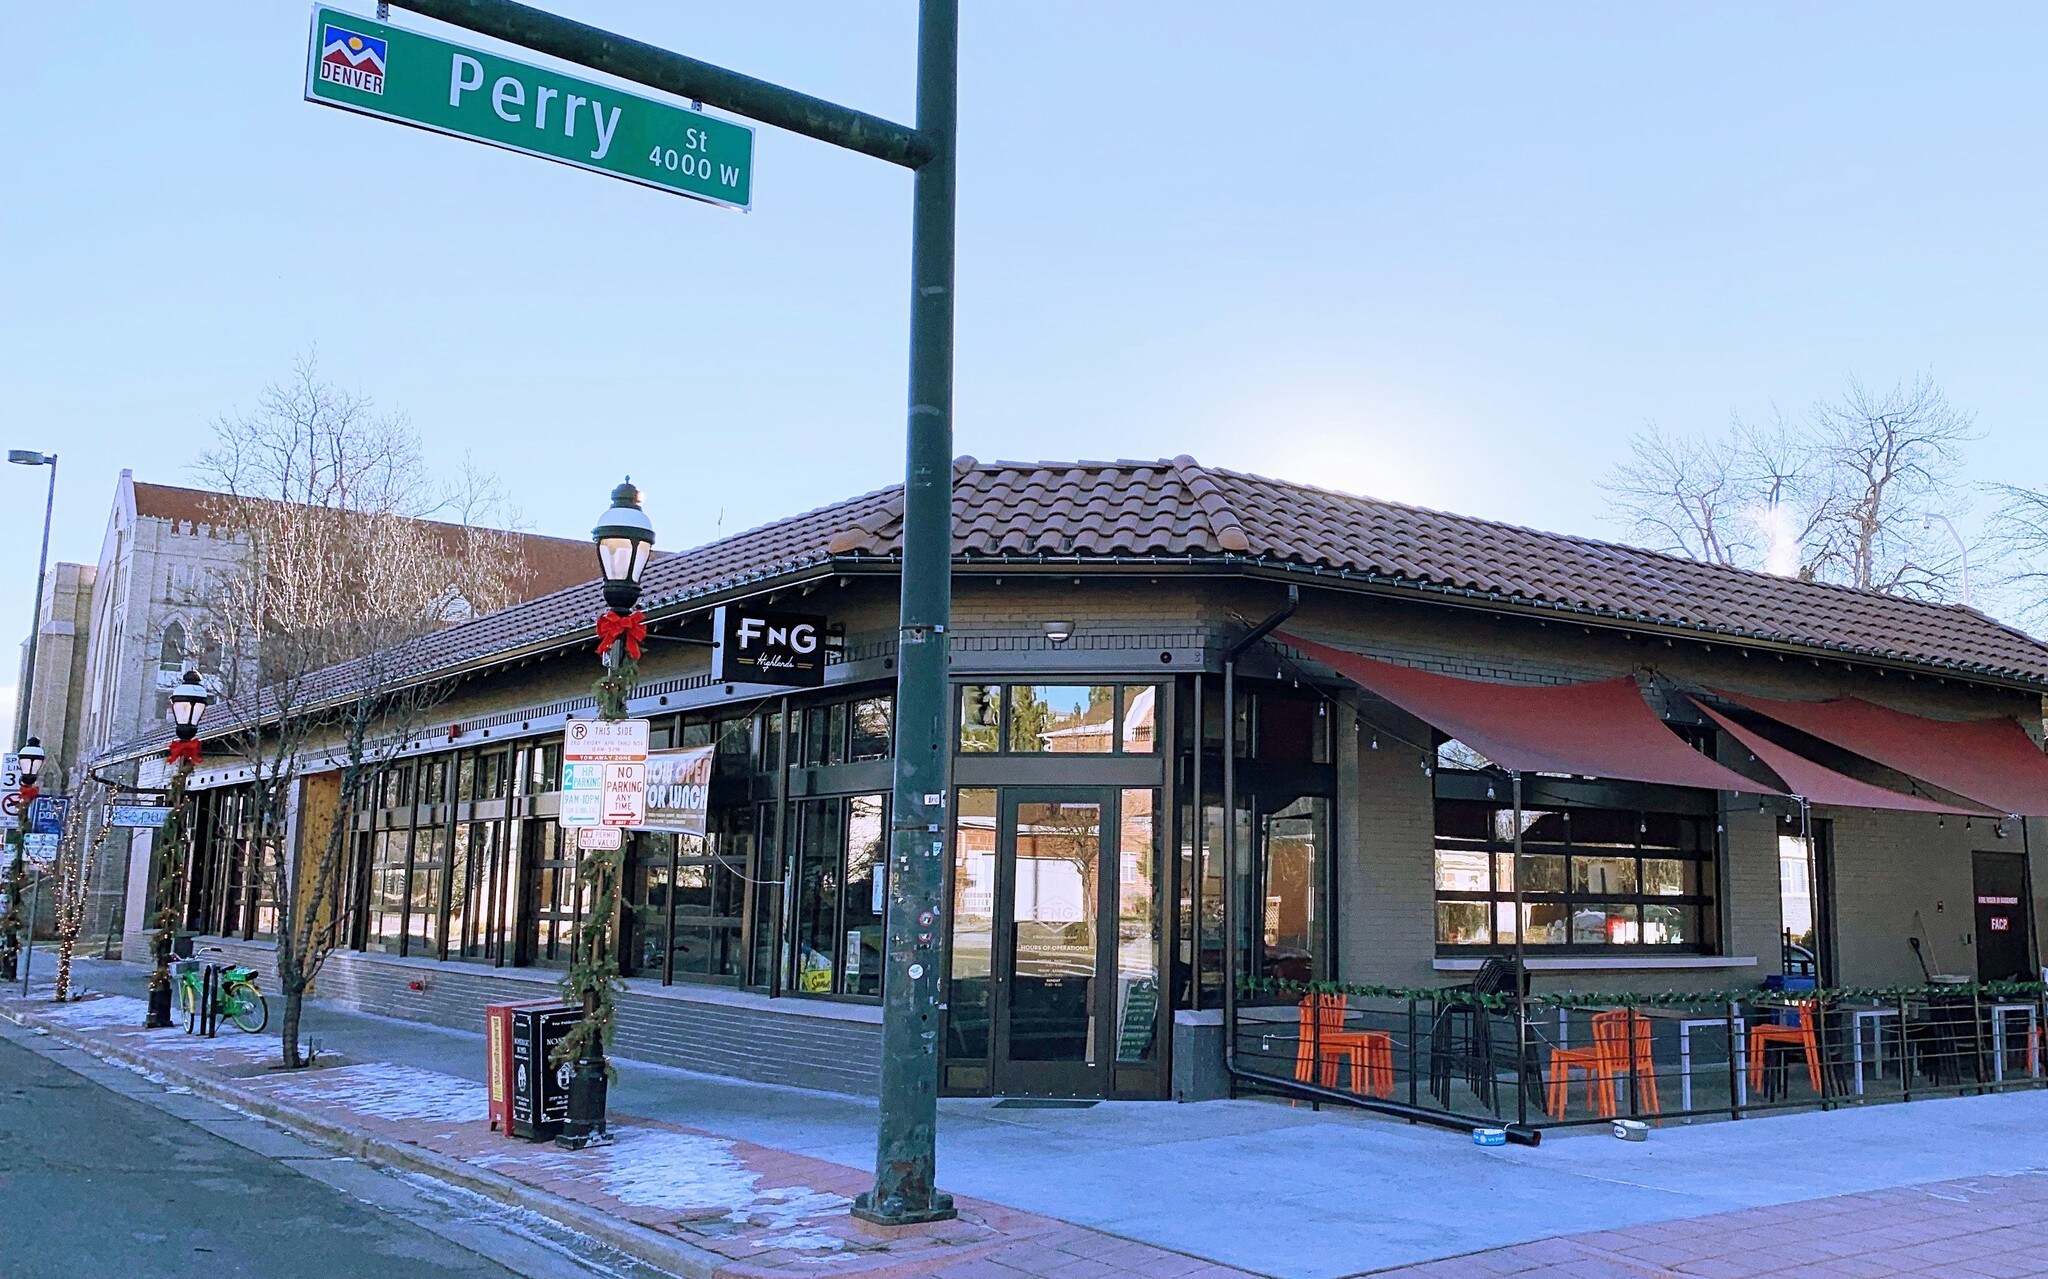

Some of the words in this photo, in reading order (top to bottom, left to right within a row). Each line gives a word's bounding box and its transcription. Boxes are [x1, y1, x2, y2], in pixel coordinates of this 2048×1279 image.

[321, 61, 383, 94] DENVER
[449, 52, 622, 159] Perry
[685, 128, 708, 153] St
[649, 145, 712, 181] 4000
[720, 163, 740, 188] W
[756, 651, 795, 673] Highlands
[595, 726, 611, 736] THIS
[617, 726, 633, 736] SIDE
[564, 768, 573, 786] 2
[574, 777, 601, 788] PARKING
[582, 766, 594, 776] HR
[617, 766, 633, 779] NO
[606, 781, 643, 793] PARKING
[645, 784, 666, 809] OR
[615, 802, 632, 811] TIME
[582, 838, 595, 846] NOT
[597, 839, 617, 847] VALID
[1040, 906, 1074, 920] FNG
[1991, 918, 2007, 930] FACP
